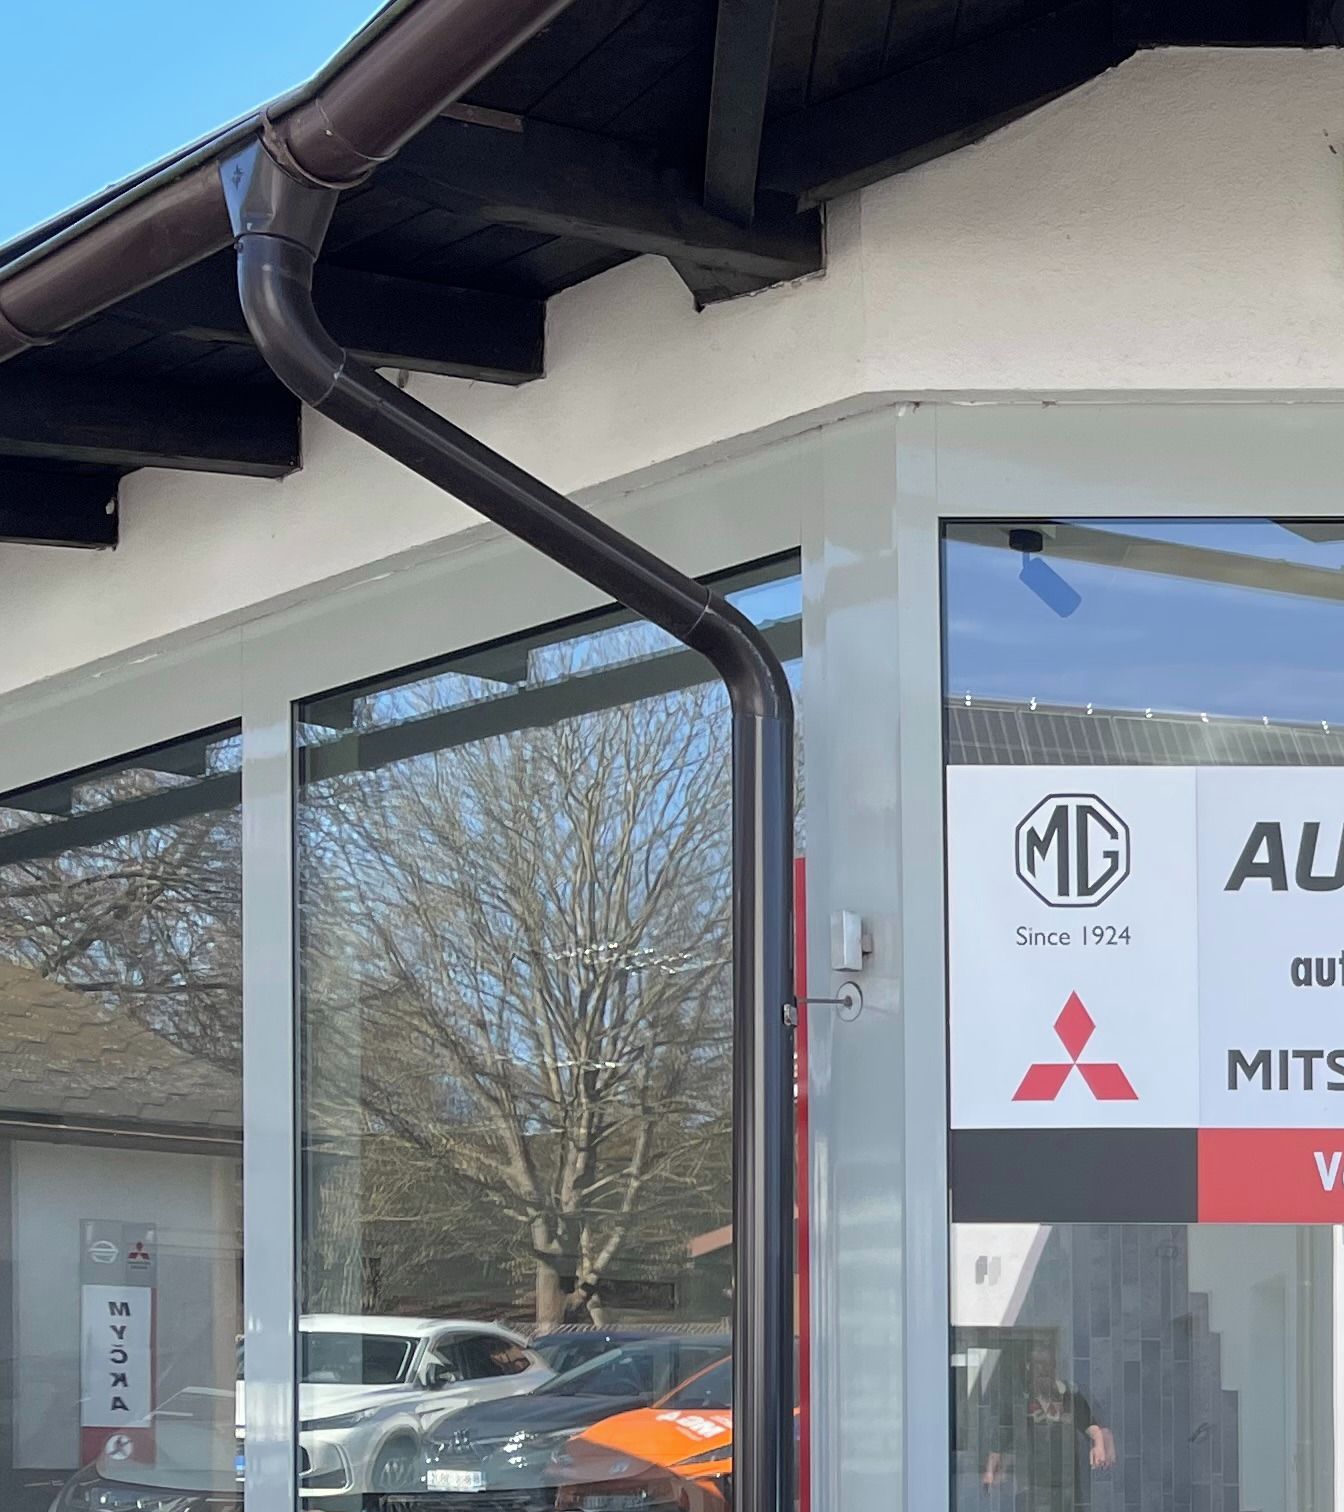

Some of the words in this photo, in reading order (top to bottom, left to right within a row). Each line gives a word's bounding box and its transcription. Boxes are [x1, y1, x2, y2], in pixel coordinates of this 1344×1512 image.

[1023, 801, 1123, 901] MG
[1016, 925, 1071, 946] Since
[1082, 925, 1131, 946] 1924
